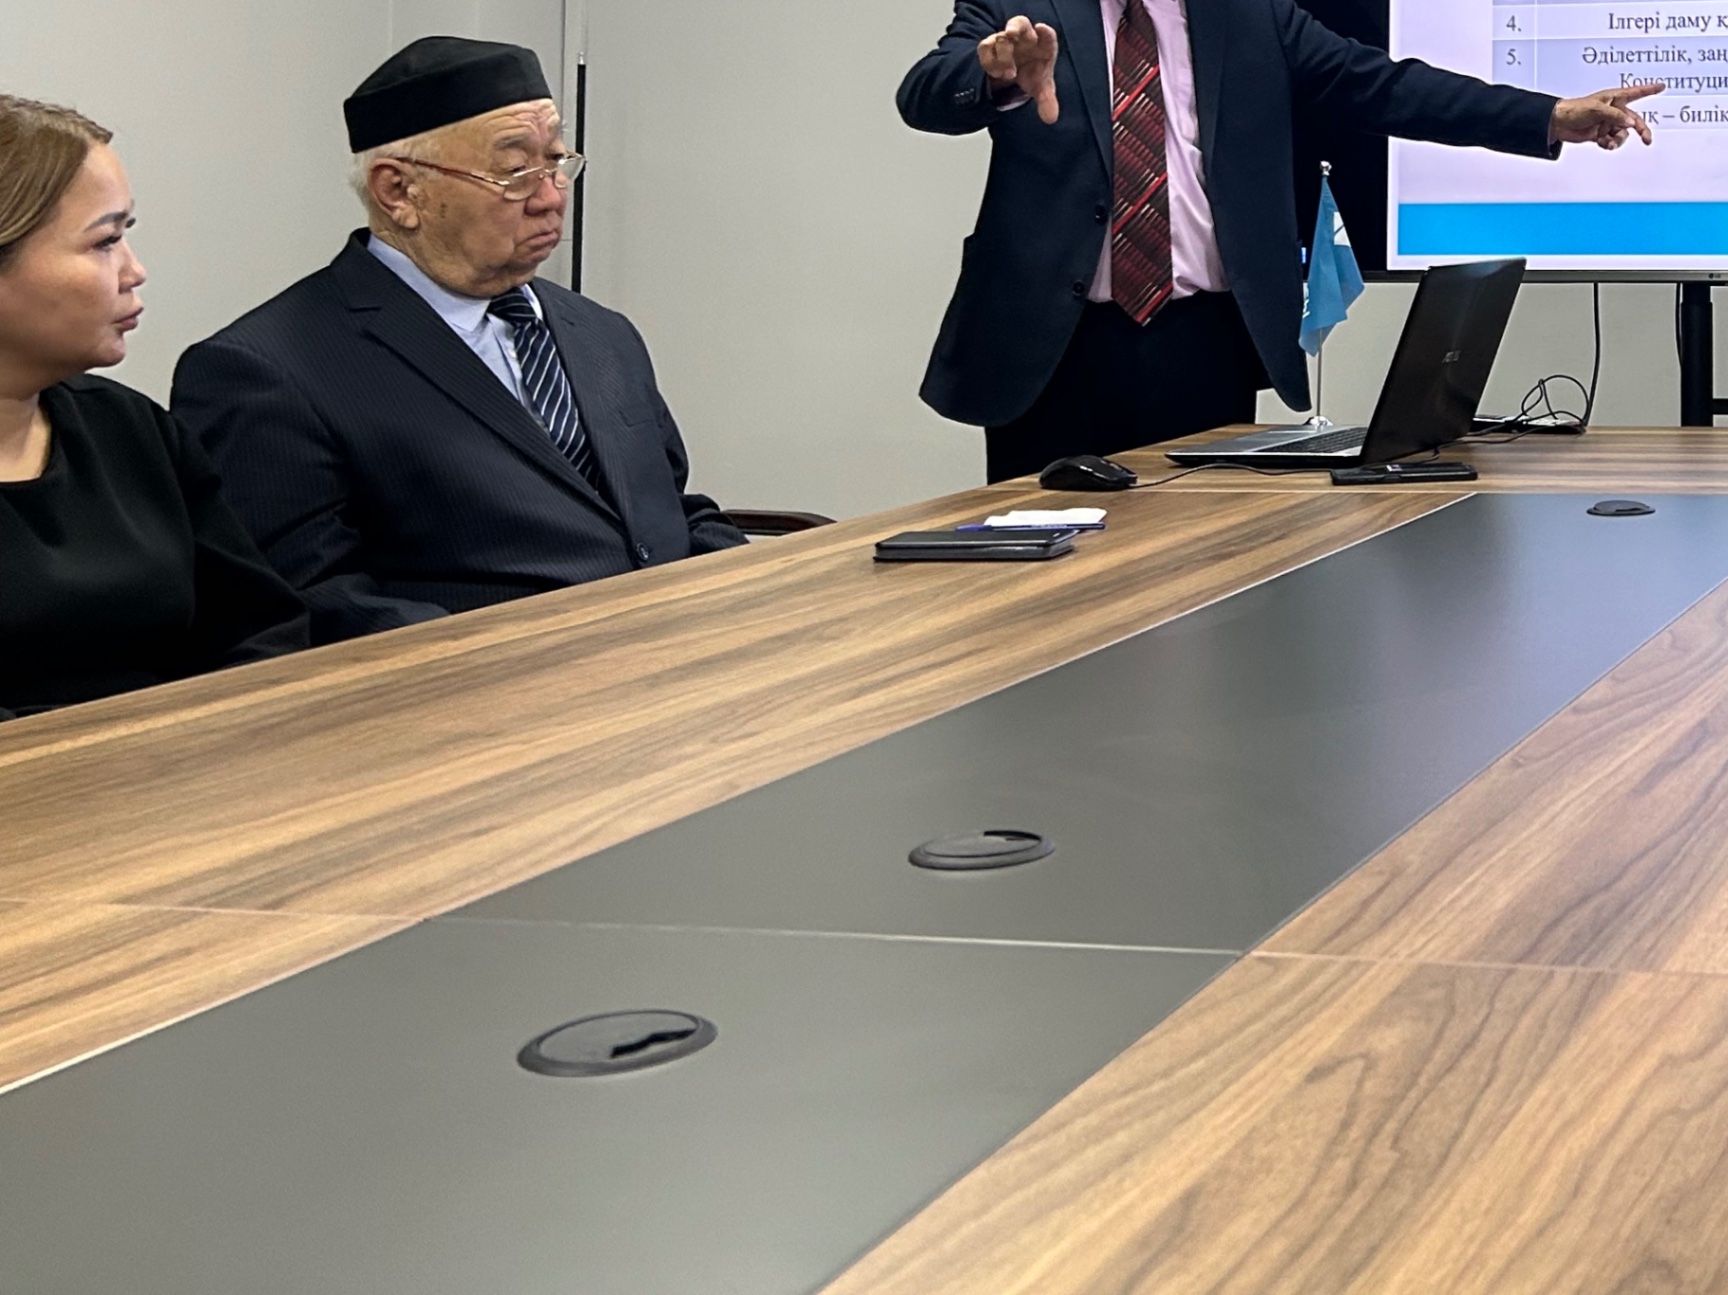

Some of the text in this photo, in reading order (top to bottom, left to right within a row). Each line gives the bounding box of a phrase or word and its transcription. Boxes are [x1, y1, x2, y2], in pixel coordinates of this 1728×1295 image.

[1505, 15, 1523, 32] 4.
[1607, 11, 1661, 34] Ілгері
[1665, 15, 1712, 32] даму
[1505, 49, 1523, 65] 5.
[1581, 46, 1693, 65] Әділеттілік,
[1697, 48, 1728, 62] заң
